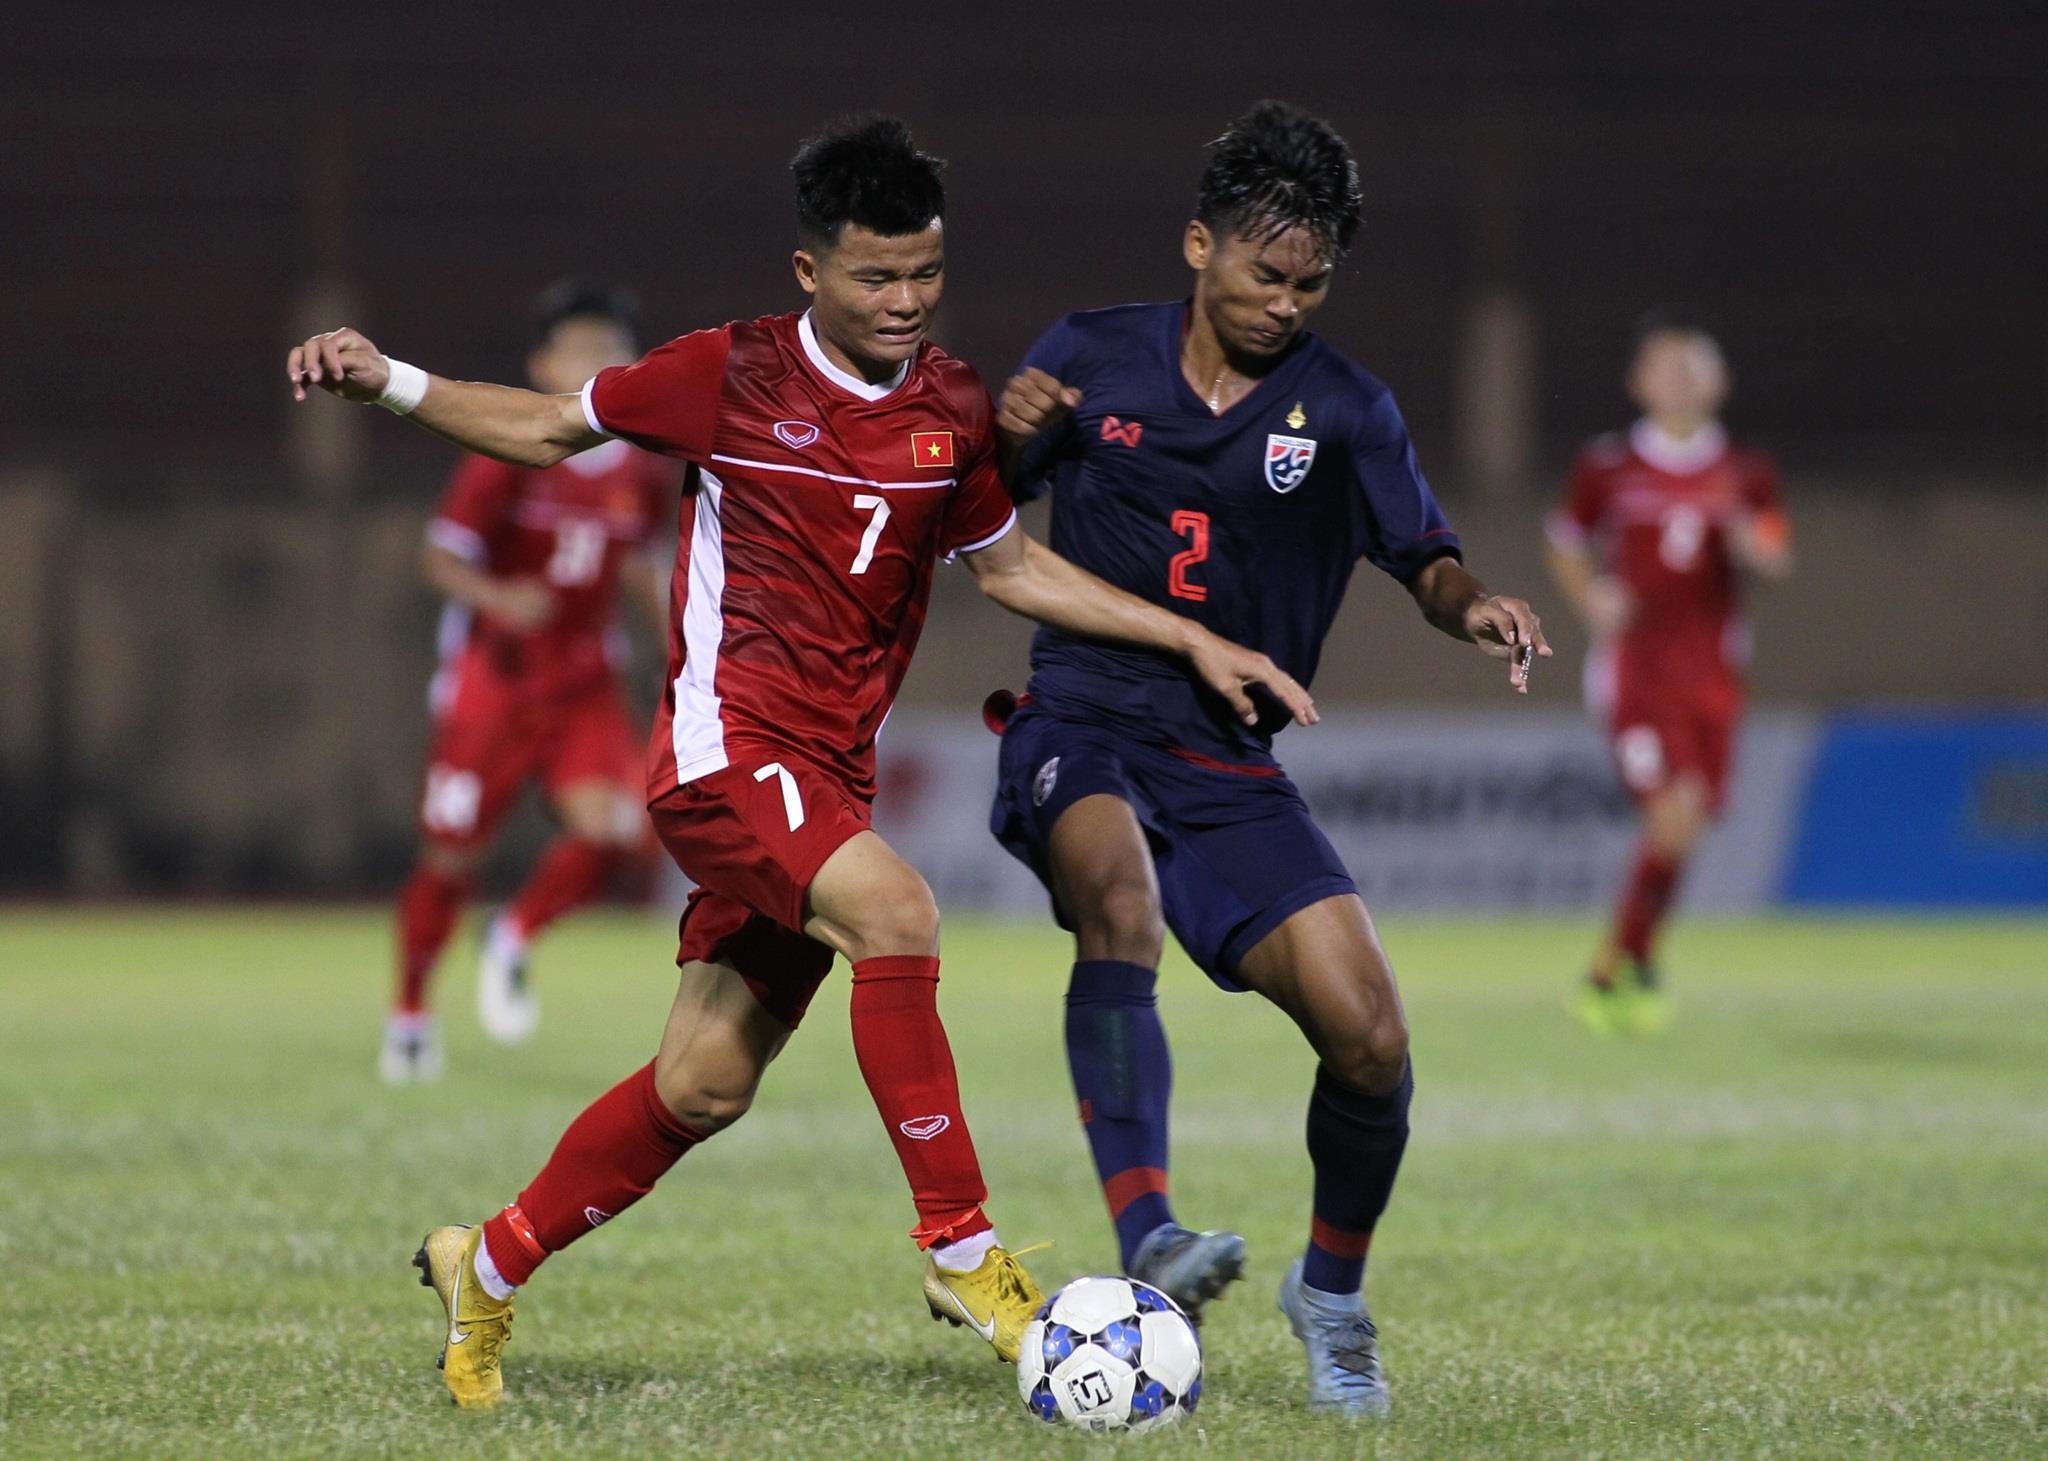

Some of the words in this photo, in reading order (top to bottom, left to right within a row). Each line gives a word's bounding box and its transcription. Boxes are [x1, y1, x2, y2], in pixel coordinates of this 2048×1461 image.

[850, 494, 891, 574] 7
[1169, 510, 1209, 602] 2
[753, 762, 805, 832] 7
